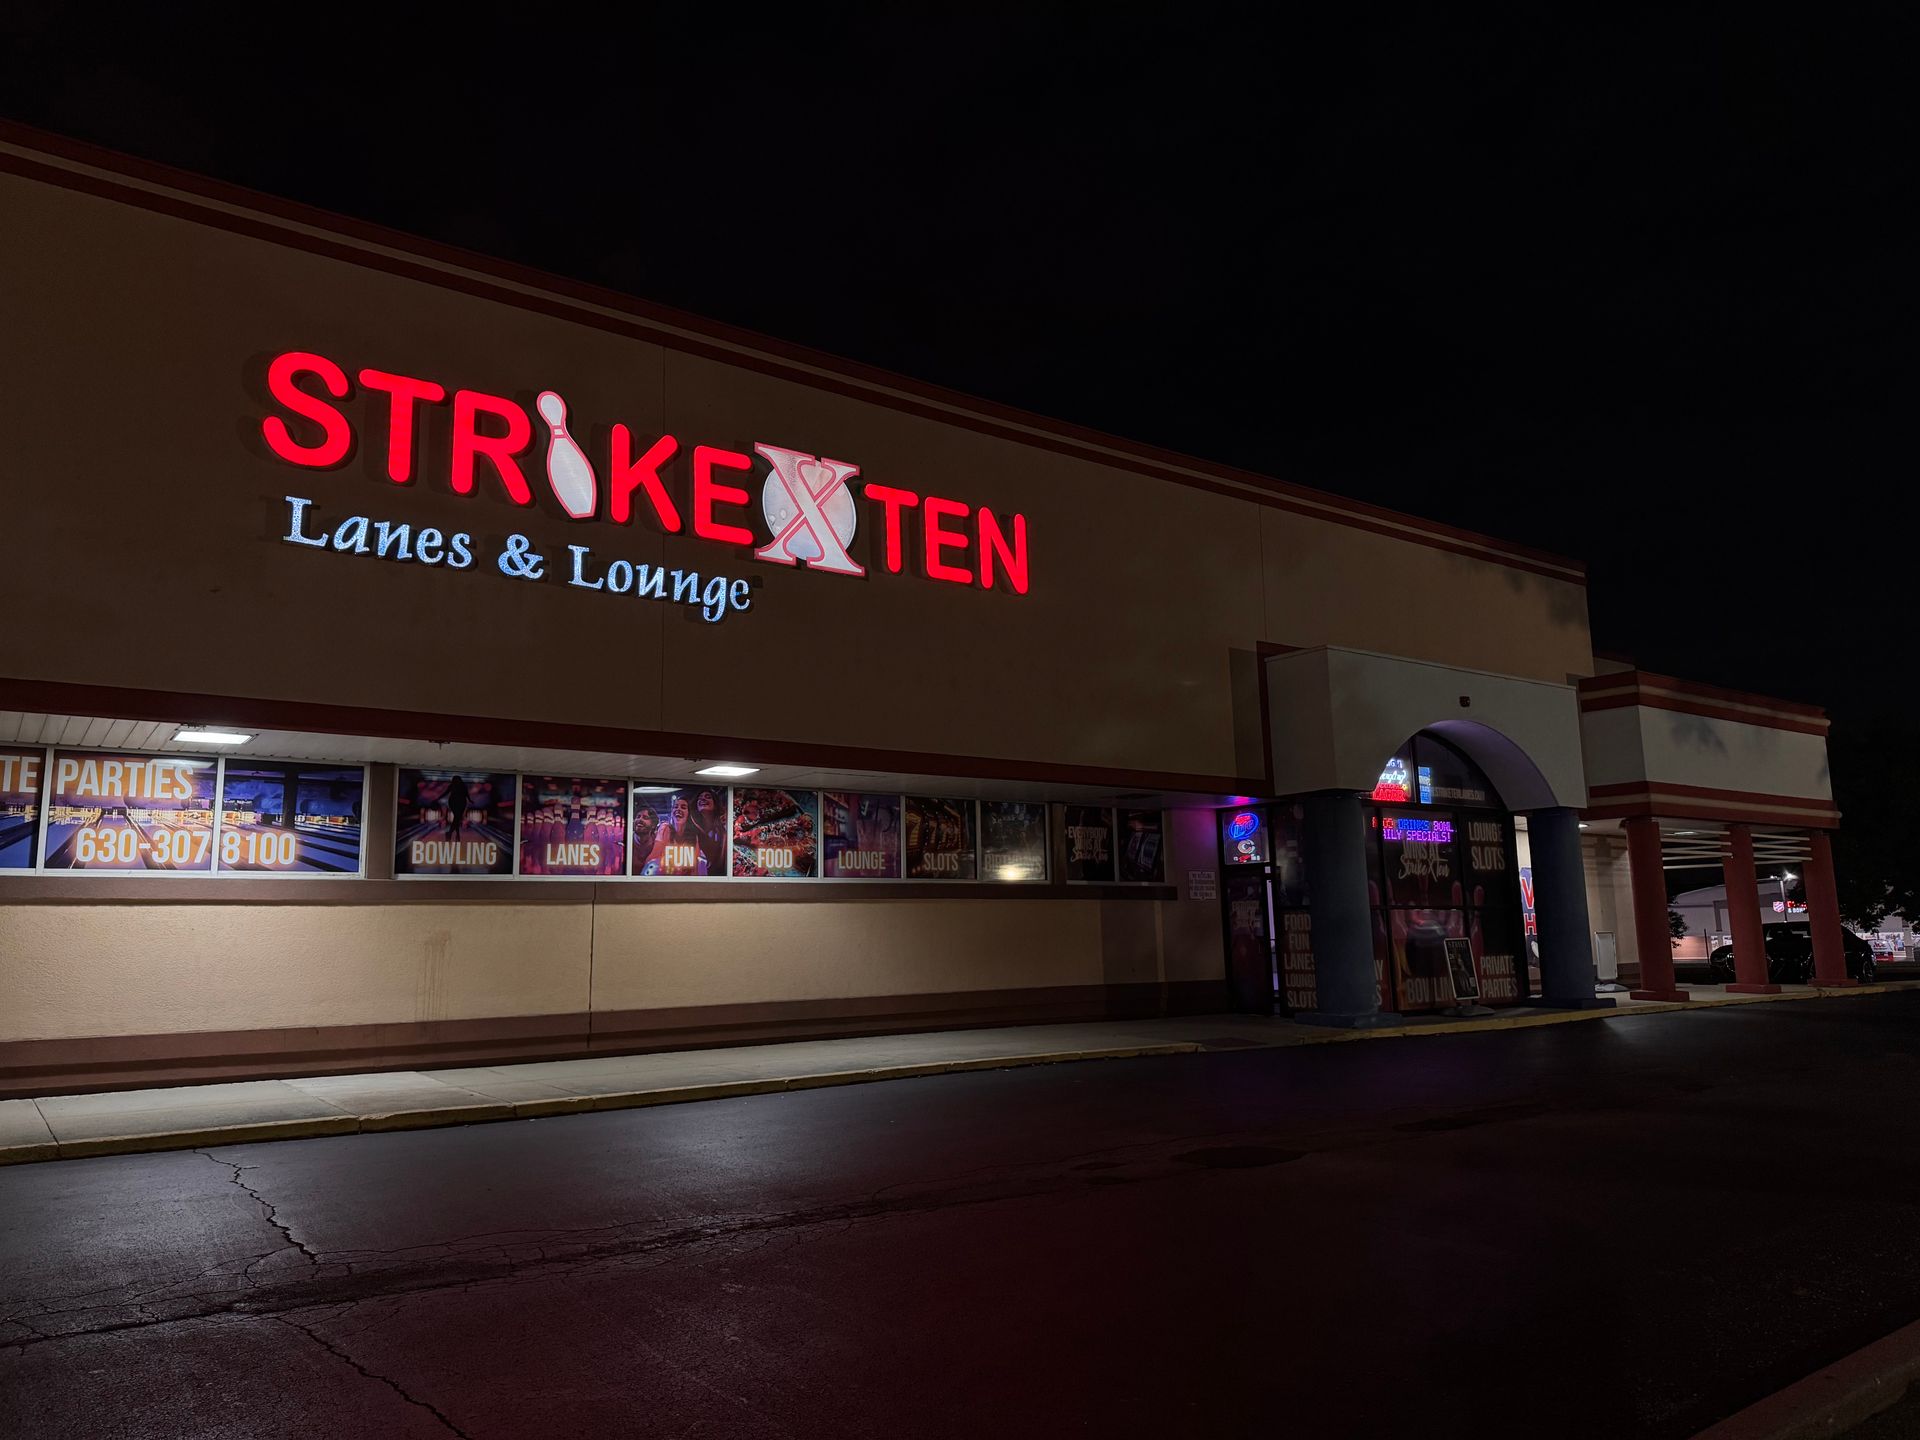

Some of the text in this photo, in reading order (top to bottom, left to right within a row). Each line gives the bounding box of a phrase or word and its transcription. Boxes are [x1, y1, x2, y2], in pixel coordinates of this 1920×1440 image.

[282, 495, 753, 624] Lanes & Lounge
[56, 758, 194, 800] PARTIES
[1406, 830, 1452, 843] SPECIALS!
[1468, 821, 1504, 842] LOUNGE
[411, 840, 497, 866] BOWLING
[546, 842, 600, 867] LANES
[664, 845, 695, 868] FUN
[757, 848, 793, 869] FOOD
[838, 850, 886, 871] LOUNGE
[923, 851, 959, 872] SLOTS
[1471, 845, 1506, 871] SLOTS
[1284, 914, 1312, 931] FOOD
[1288, 933, 1311, 951] FUN
[1480, 955, 1516, 976] PRIVATE
[1406, 976, 1454, 1004] BOWLIN
[1482, 977, 1518, 998] PARTIES
